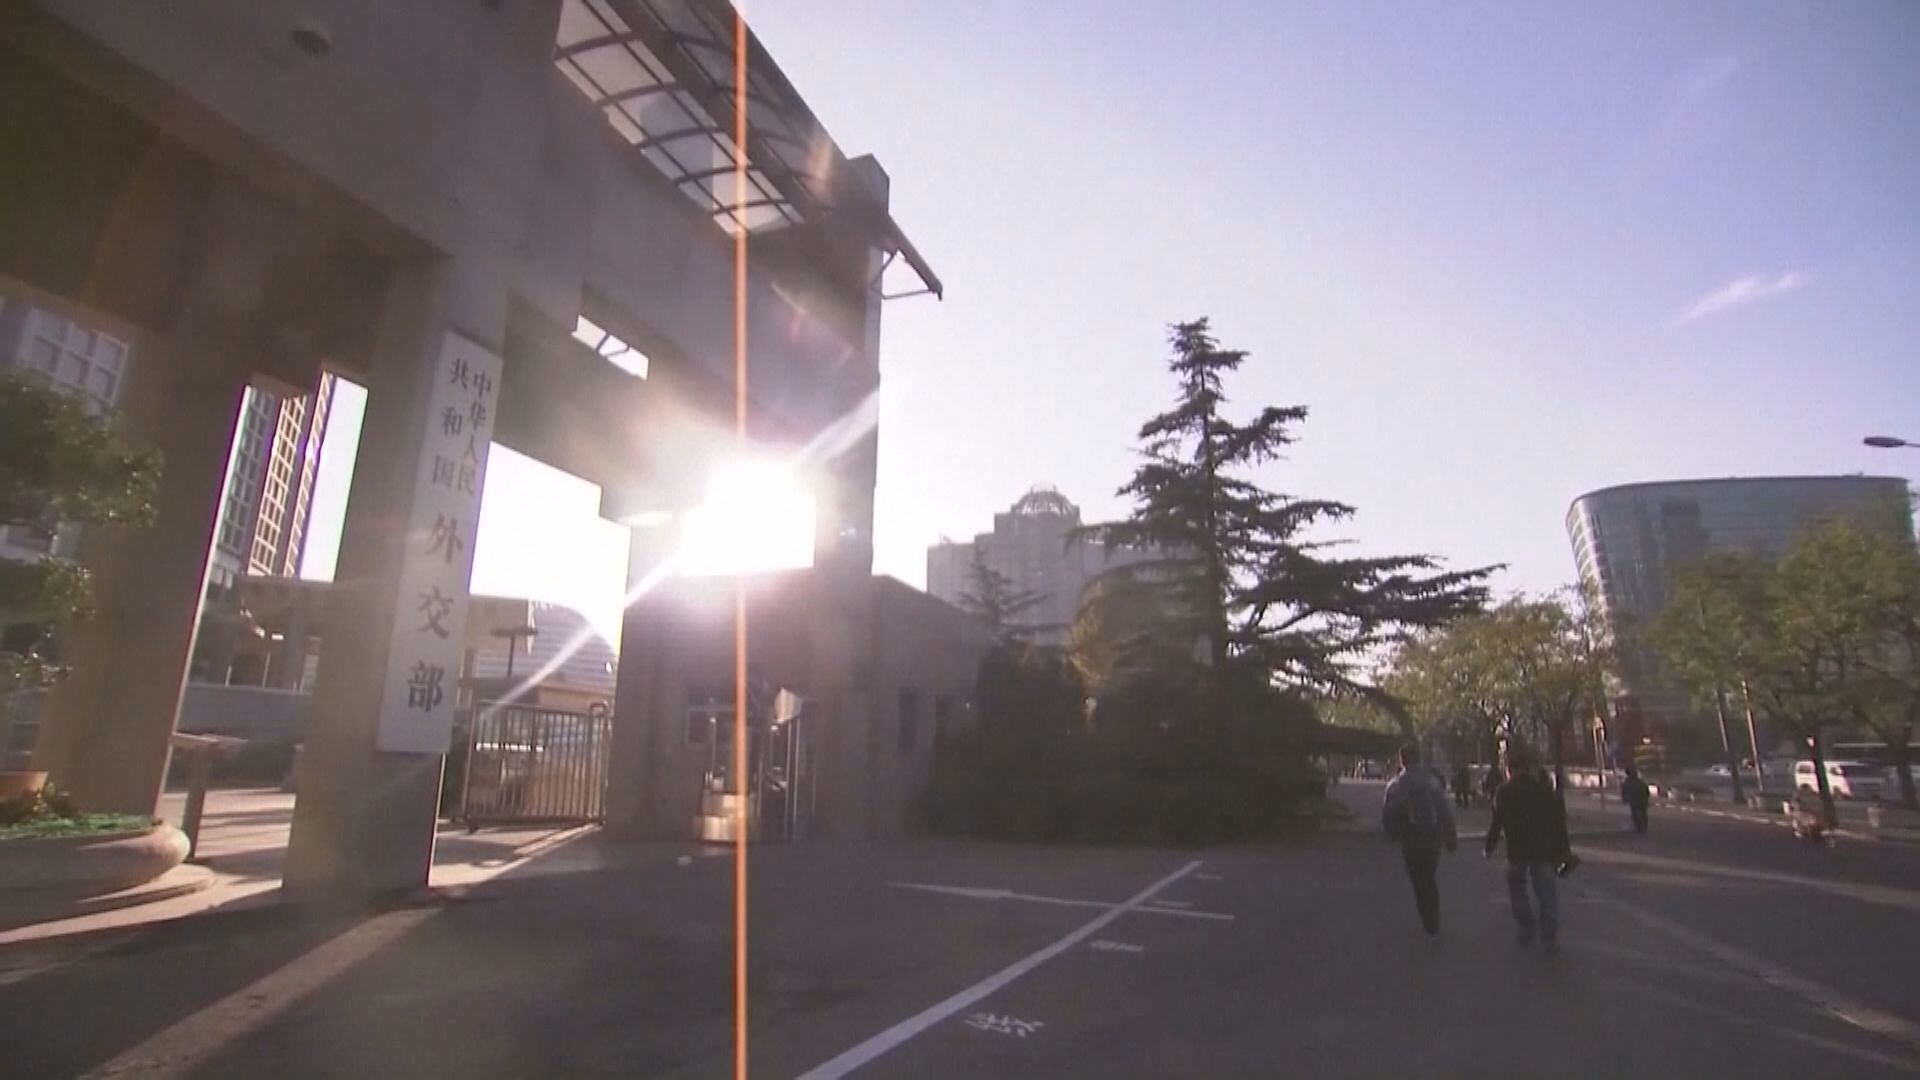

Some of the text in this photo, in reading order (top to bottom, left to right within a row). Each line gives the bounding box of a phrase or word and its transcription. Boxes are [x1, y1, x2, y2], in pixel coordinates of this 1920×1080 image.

[432, 358, 469, 488] 共和国
[458, 371, 492, 495] 中华人民
[407, 512, 464, 713] 外交部
